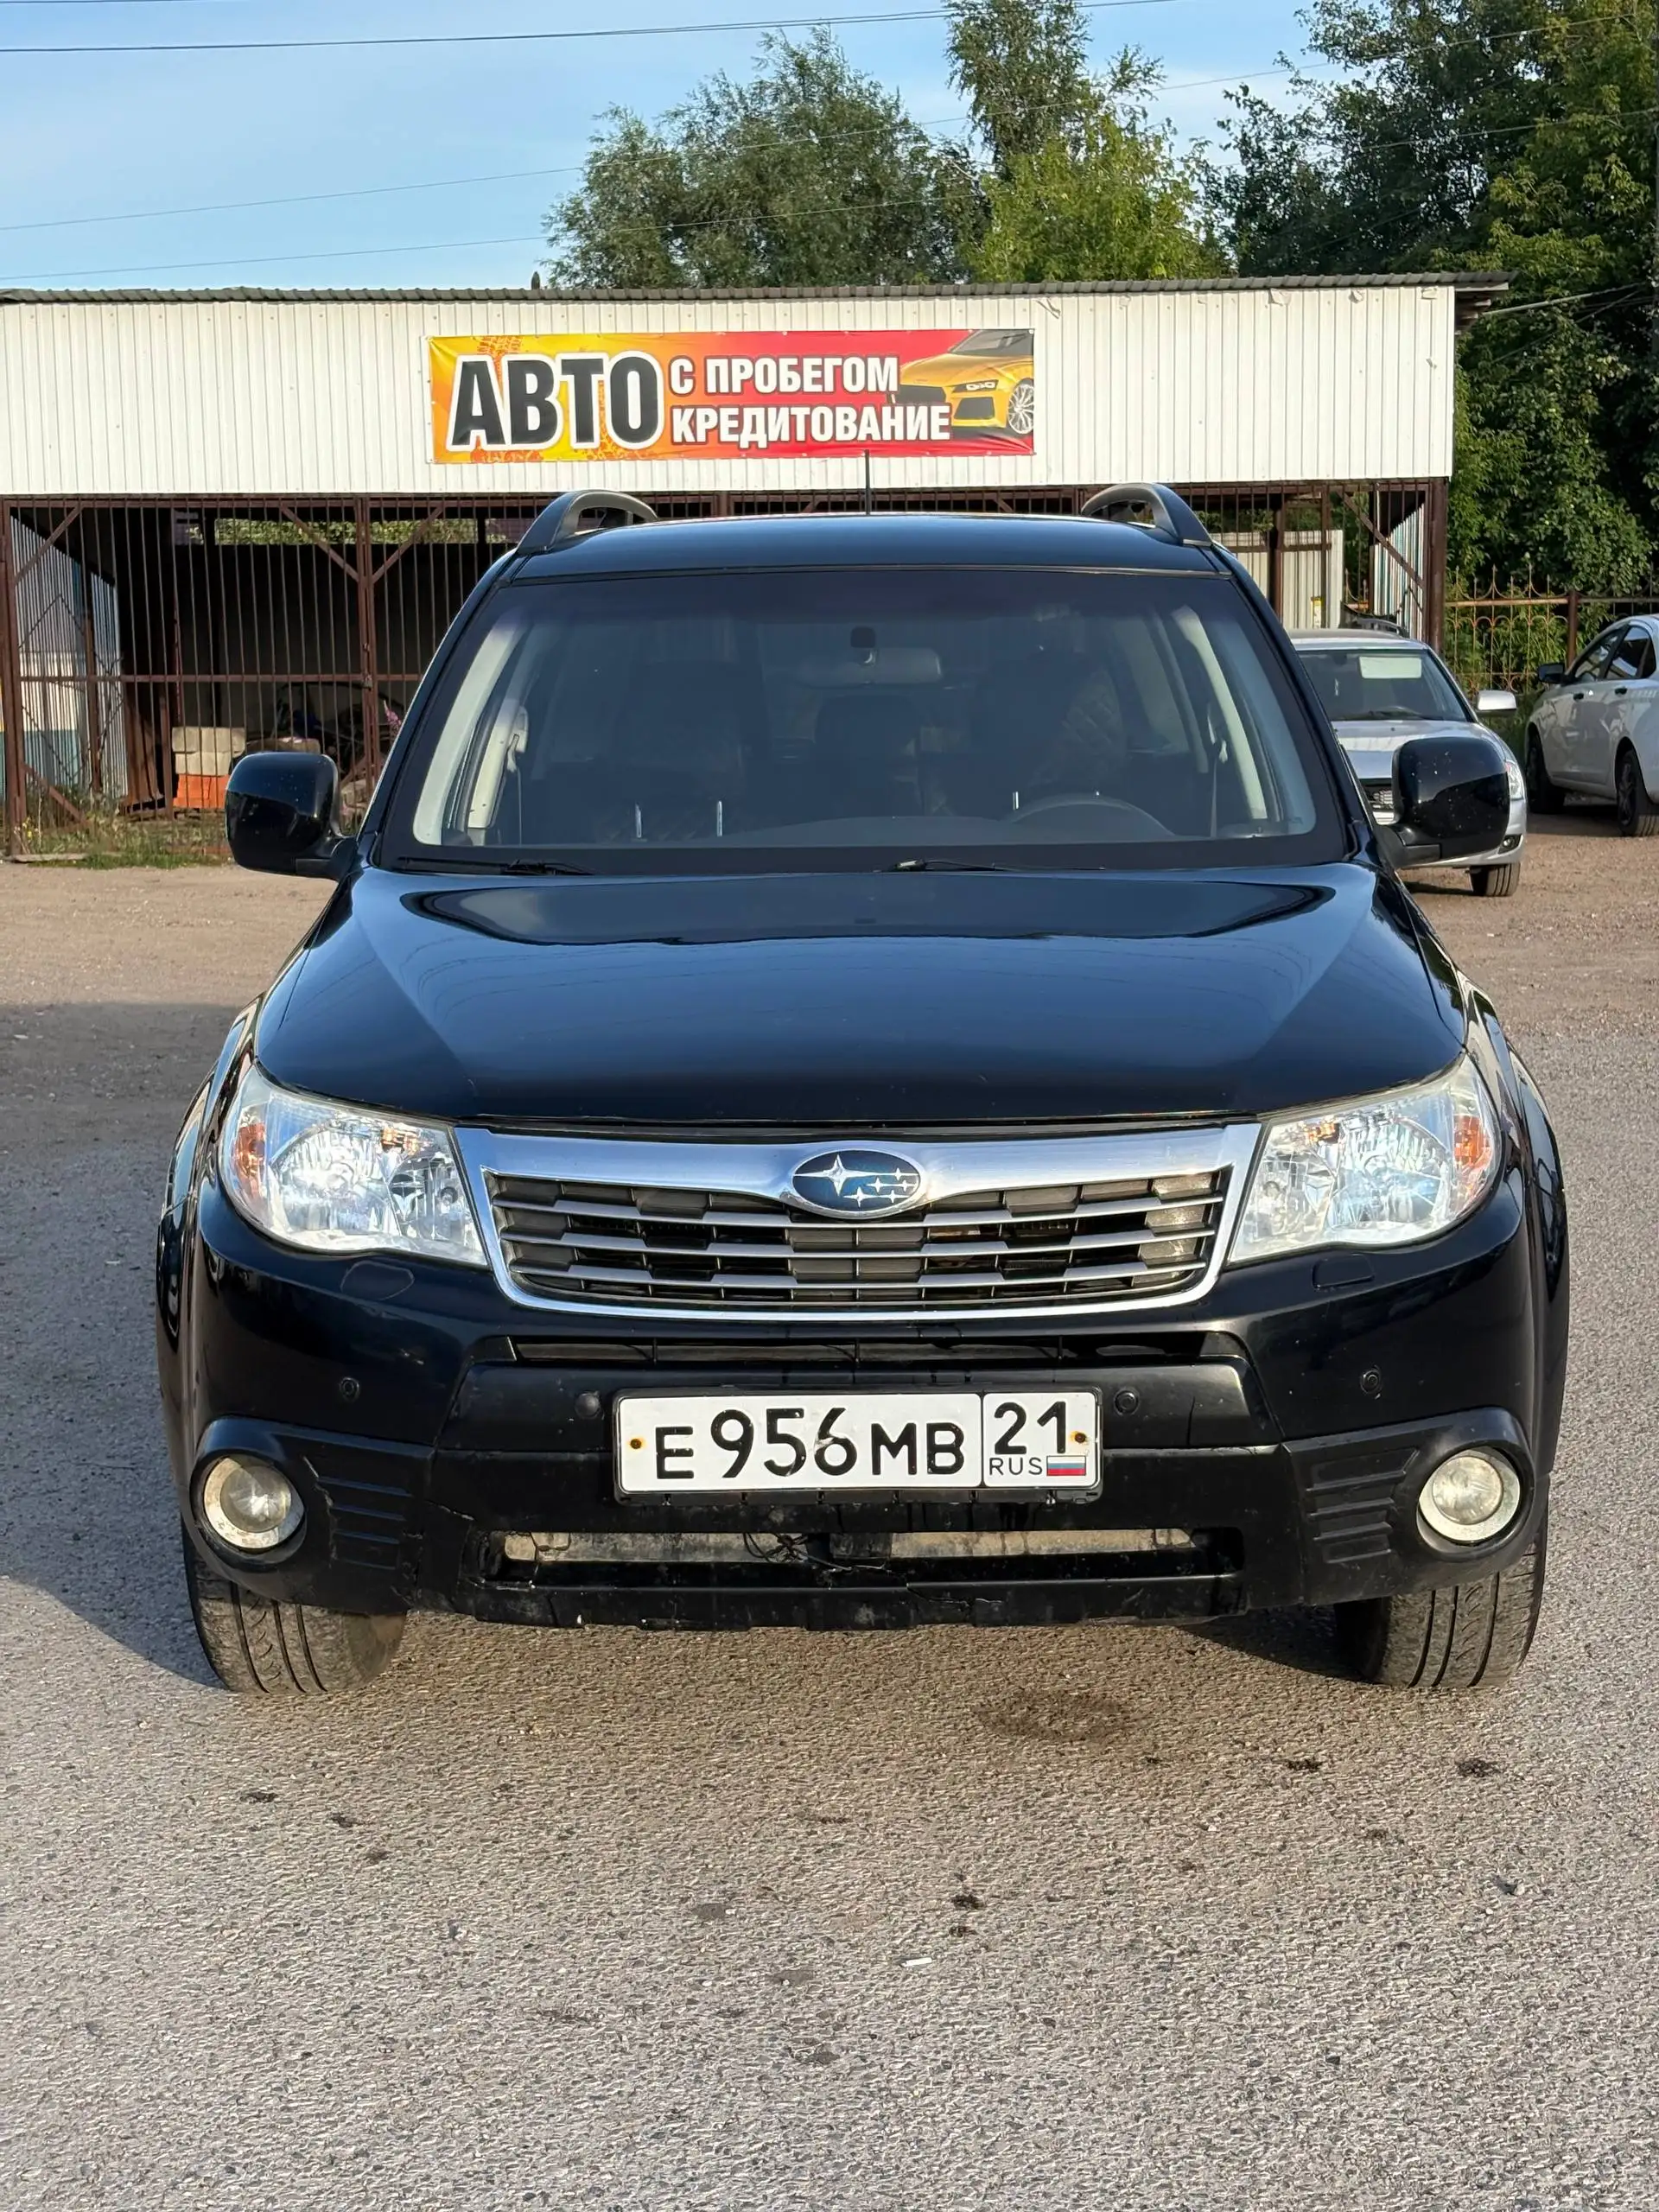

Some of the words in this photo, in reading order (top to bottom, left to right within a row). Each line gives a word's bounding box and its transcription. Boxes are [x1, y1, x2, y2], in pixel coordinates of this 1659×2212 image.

[671, 357, 693, 396] С
[706, 355, 899, 395] ПРОБЕГОМ
[449, 353, 661, 448] АВТО
[672, 404, 950, 448] КРЕДИТОВАНИЕ
[994, 1401, 1068, 1456] 21
[988, 1457, 1044, 1477] RUS
